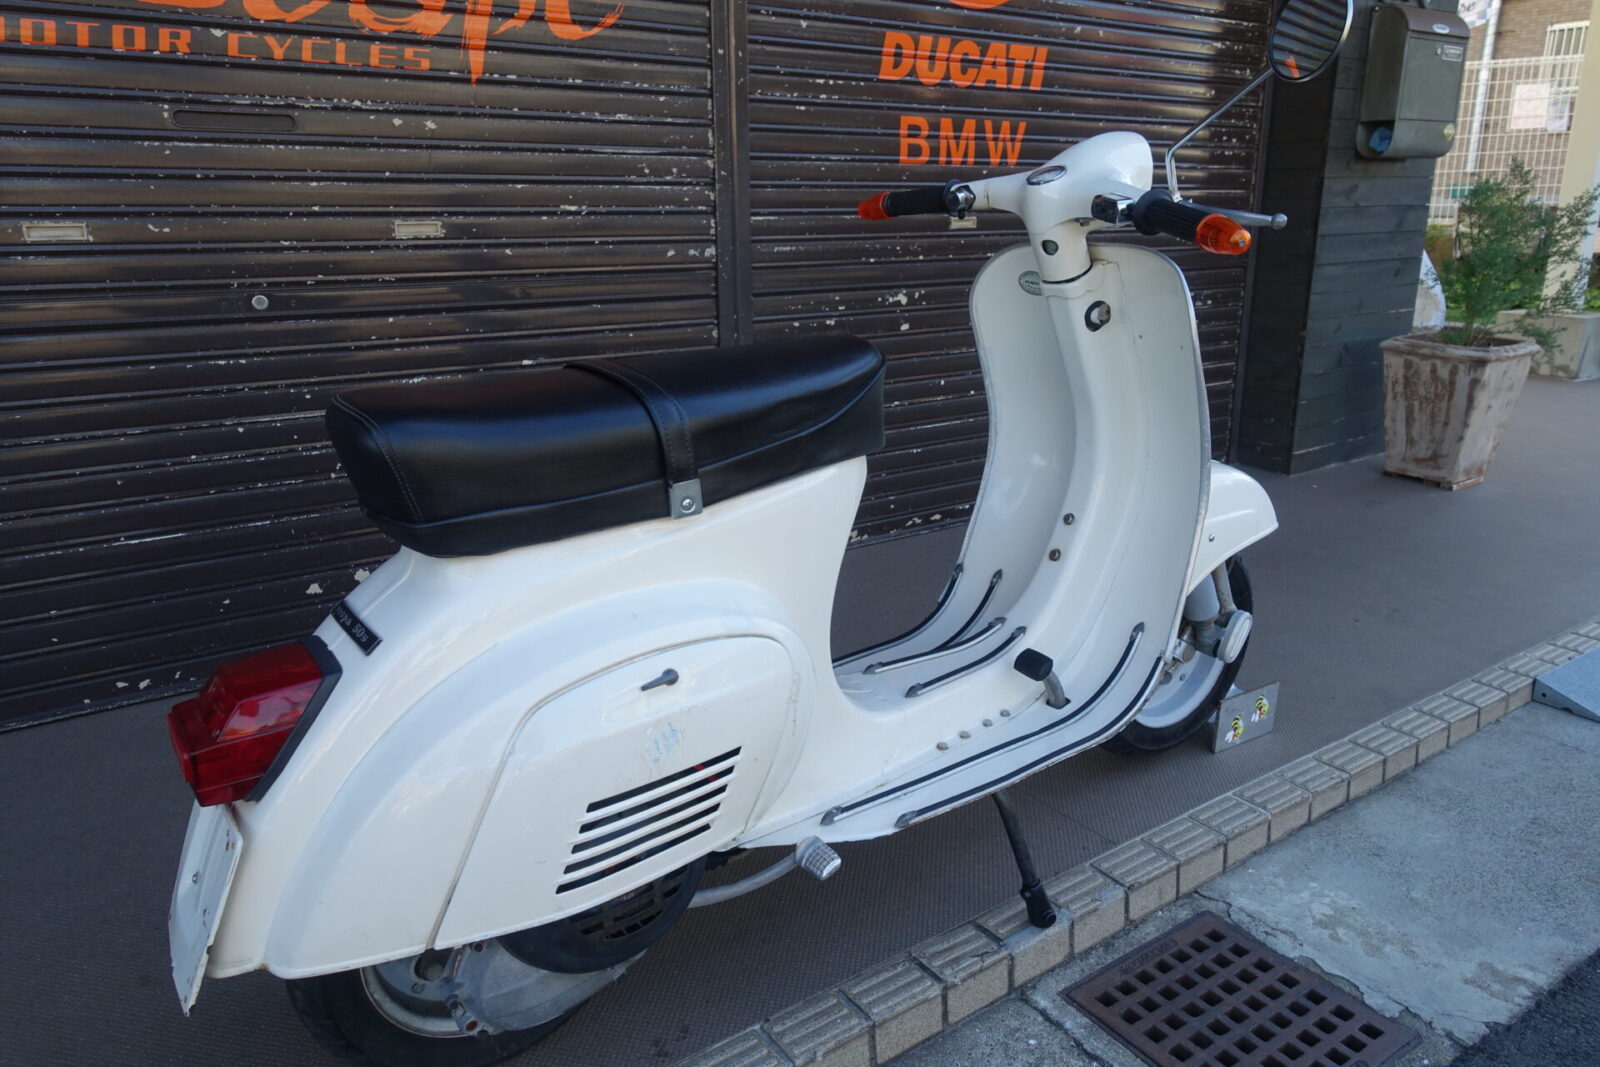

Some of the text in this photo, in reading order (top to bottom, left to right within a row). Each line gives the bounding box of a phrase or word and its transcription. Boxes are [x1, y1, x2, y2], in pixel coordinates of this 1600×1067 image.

[227, 32, 431, 71] CYCLES
[878, 31, 1048, 91] DUCATI
[898, 115, 1027, 167] BMW
